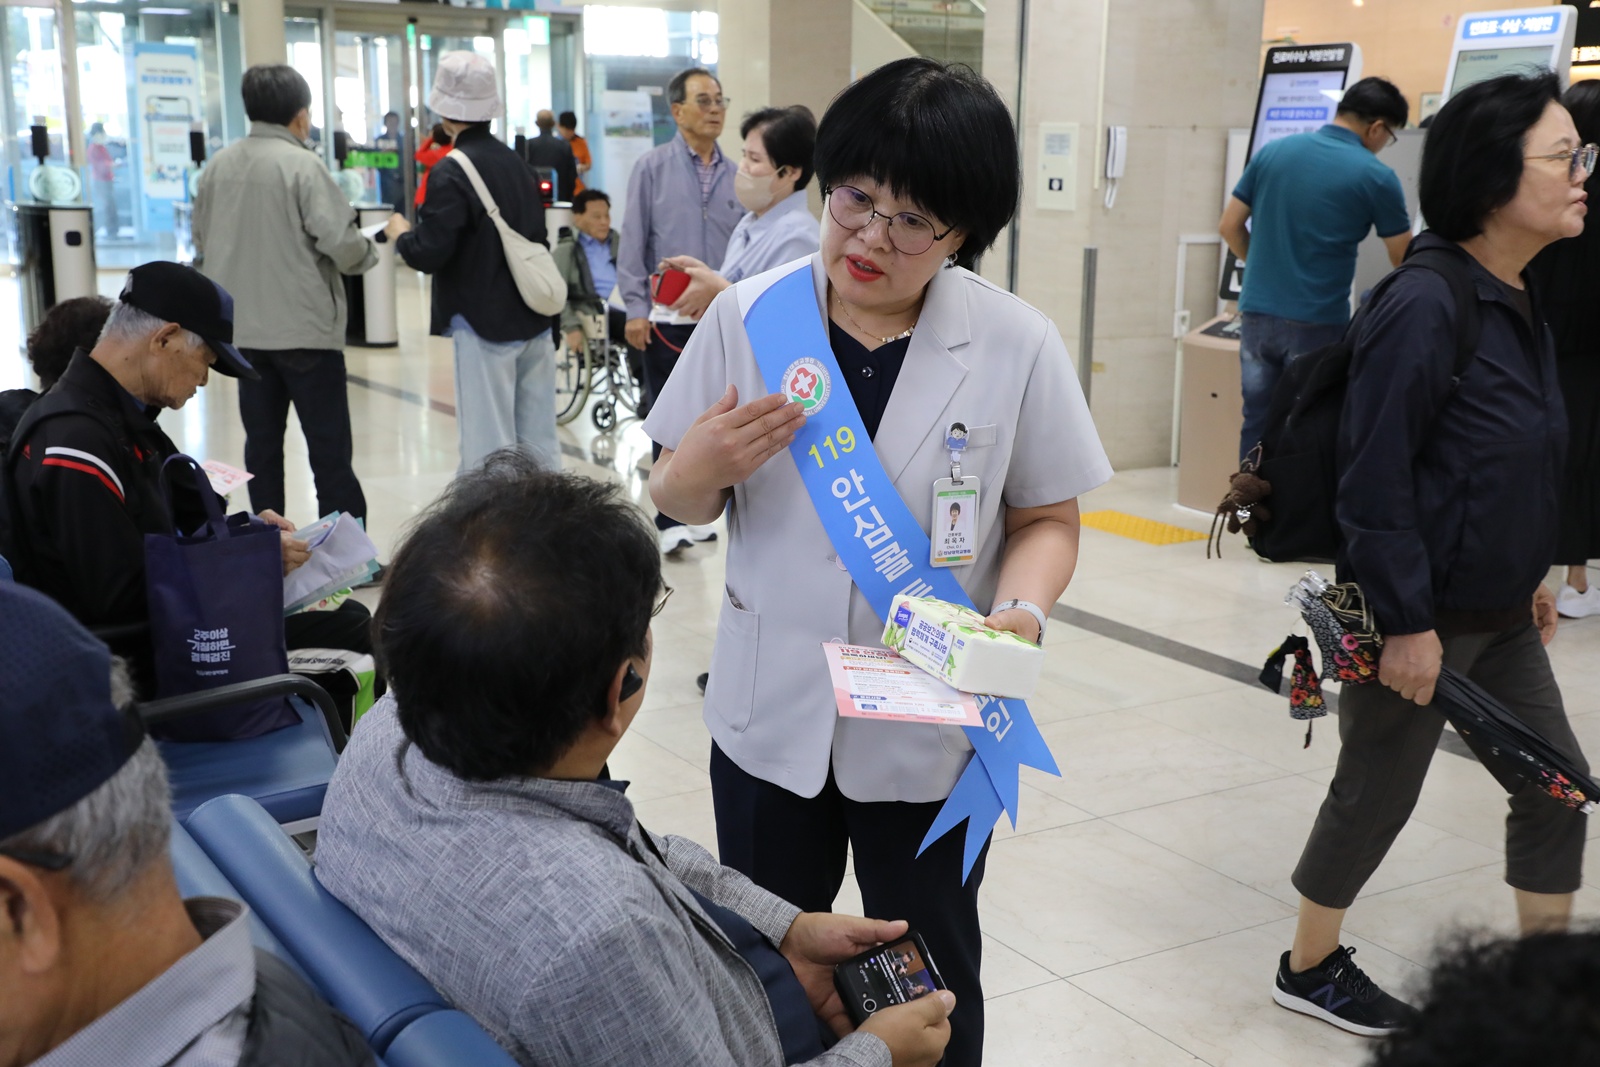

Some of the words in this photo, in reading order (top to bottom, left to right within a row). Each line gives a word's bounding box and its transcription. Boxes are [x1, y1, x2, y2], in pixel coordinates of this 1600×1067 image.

[808, 426, 856, 469] 119
[831, 468, 914, 583] 안심콜
[193, 628, 229, 641] 2주이상
